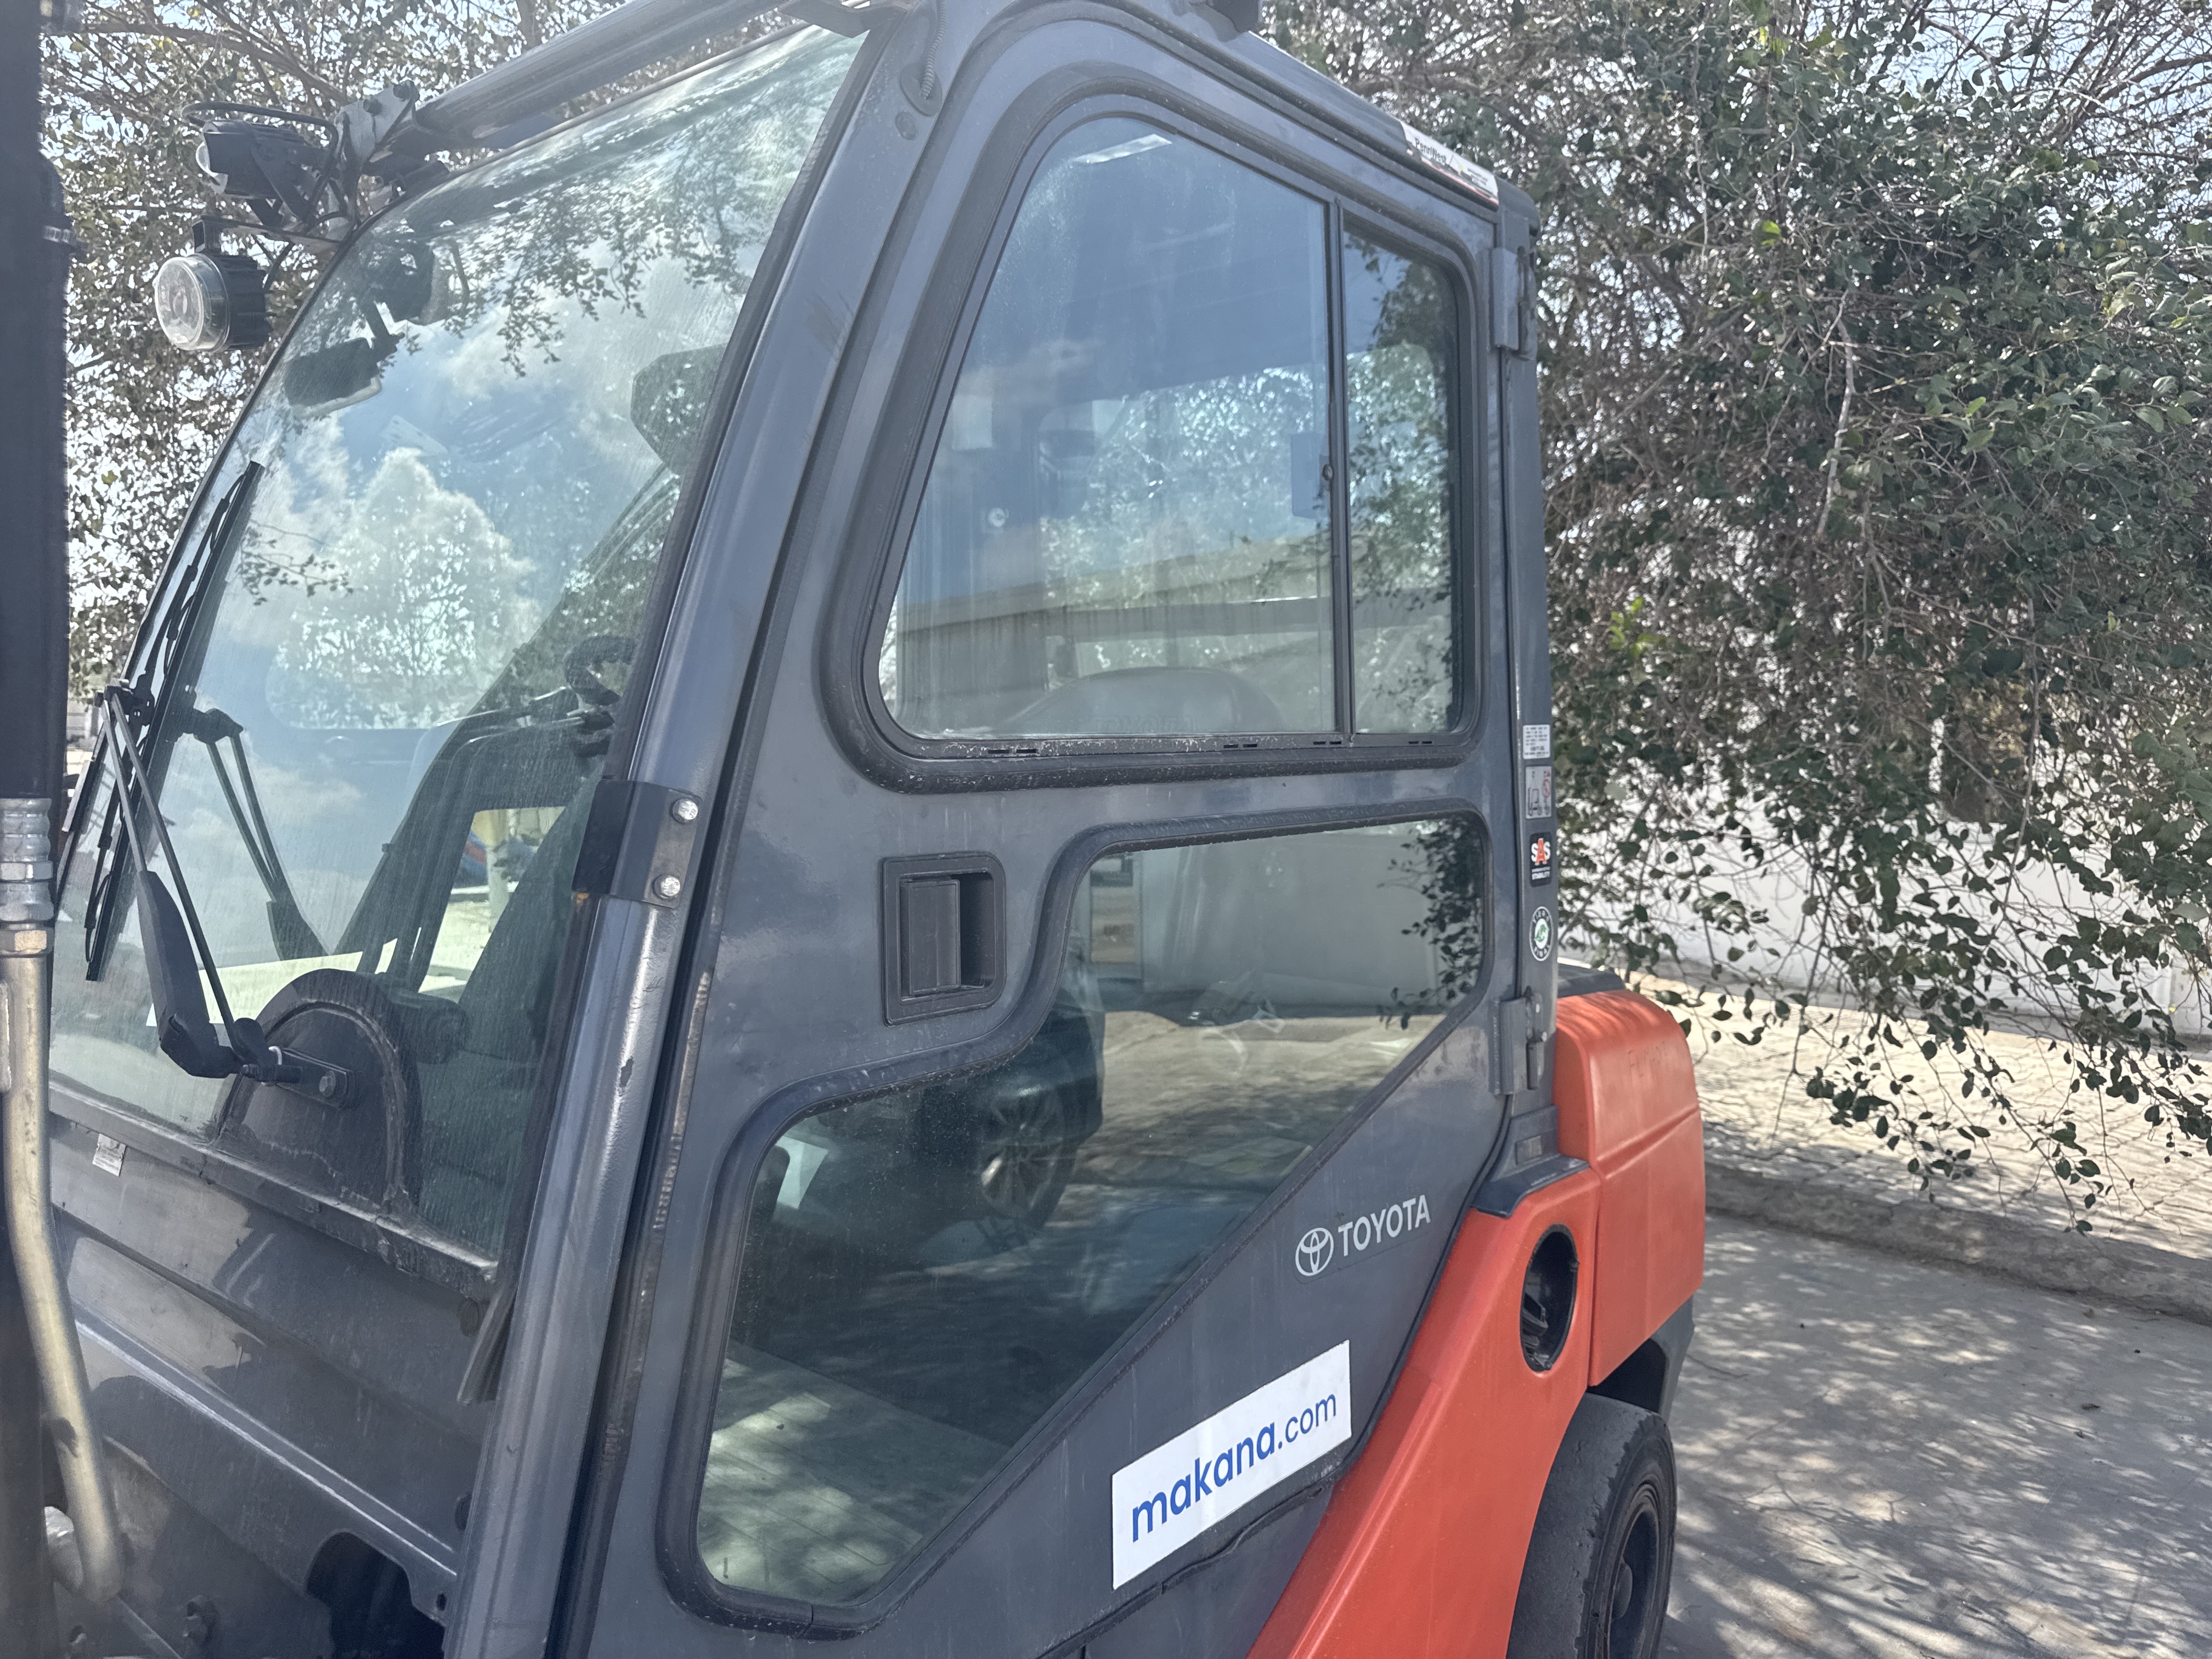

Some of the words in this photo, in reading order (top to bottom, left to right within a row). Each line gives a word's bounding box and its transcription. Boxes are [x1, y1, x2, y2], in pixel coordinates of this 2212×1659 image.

[1414, 138, 1447, 163] PennWest
[1338, 1194, 1431, 1257] TOYOTA
[1132, 1393, 1336, 1543] makana.com
